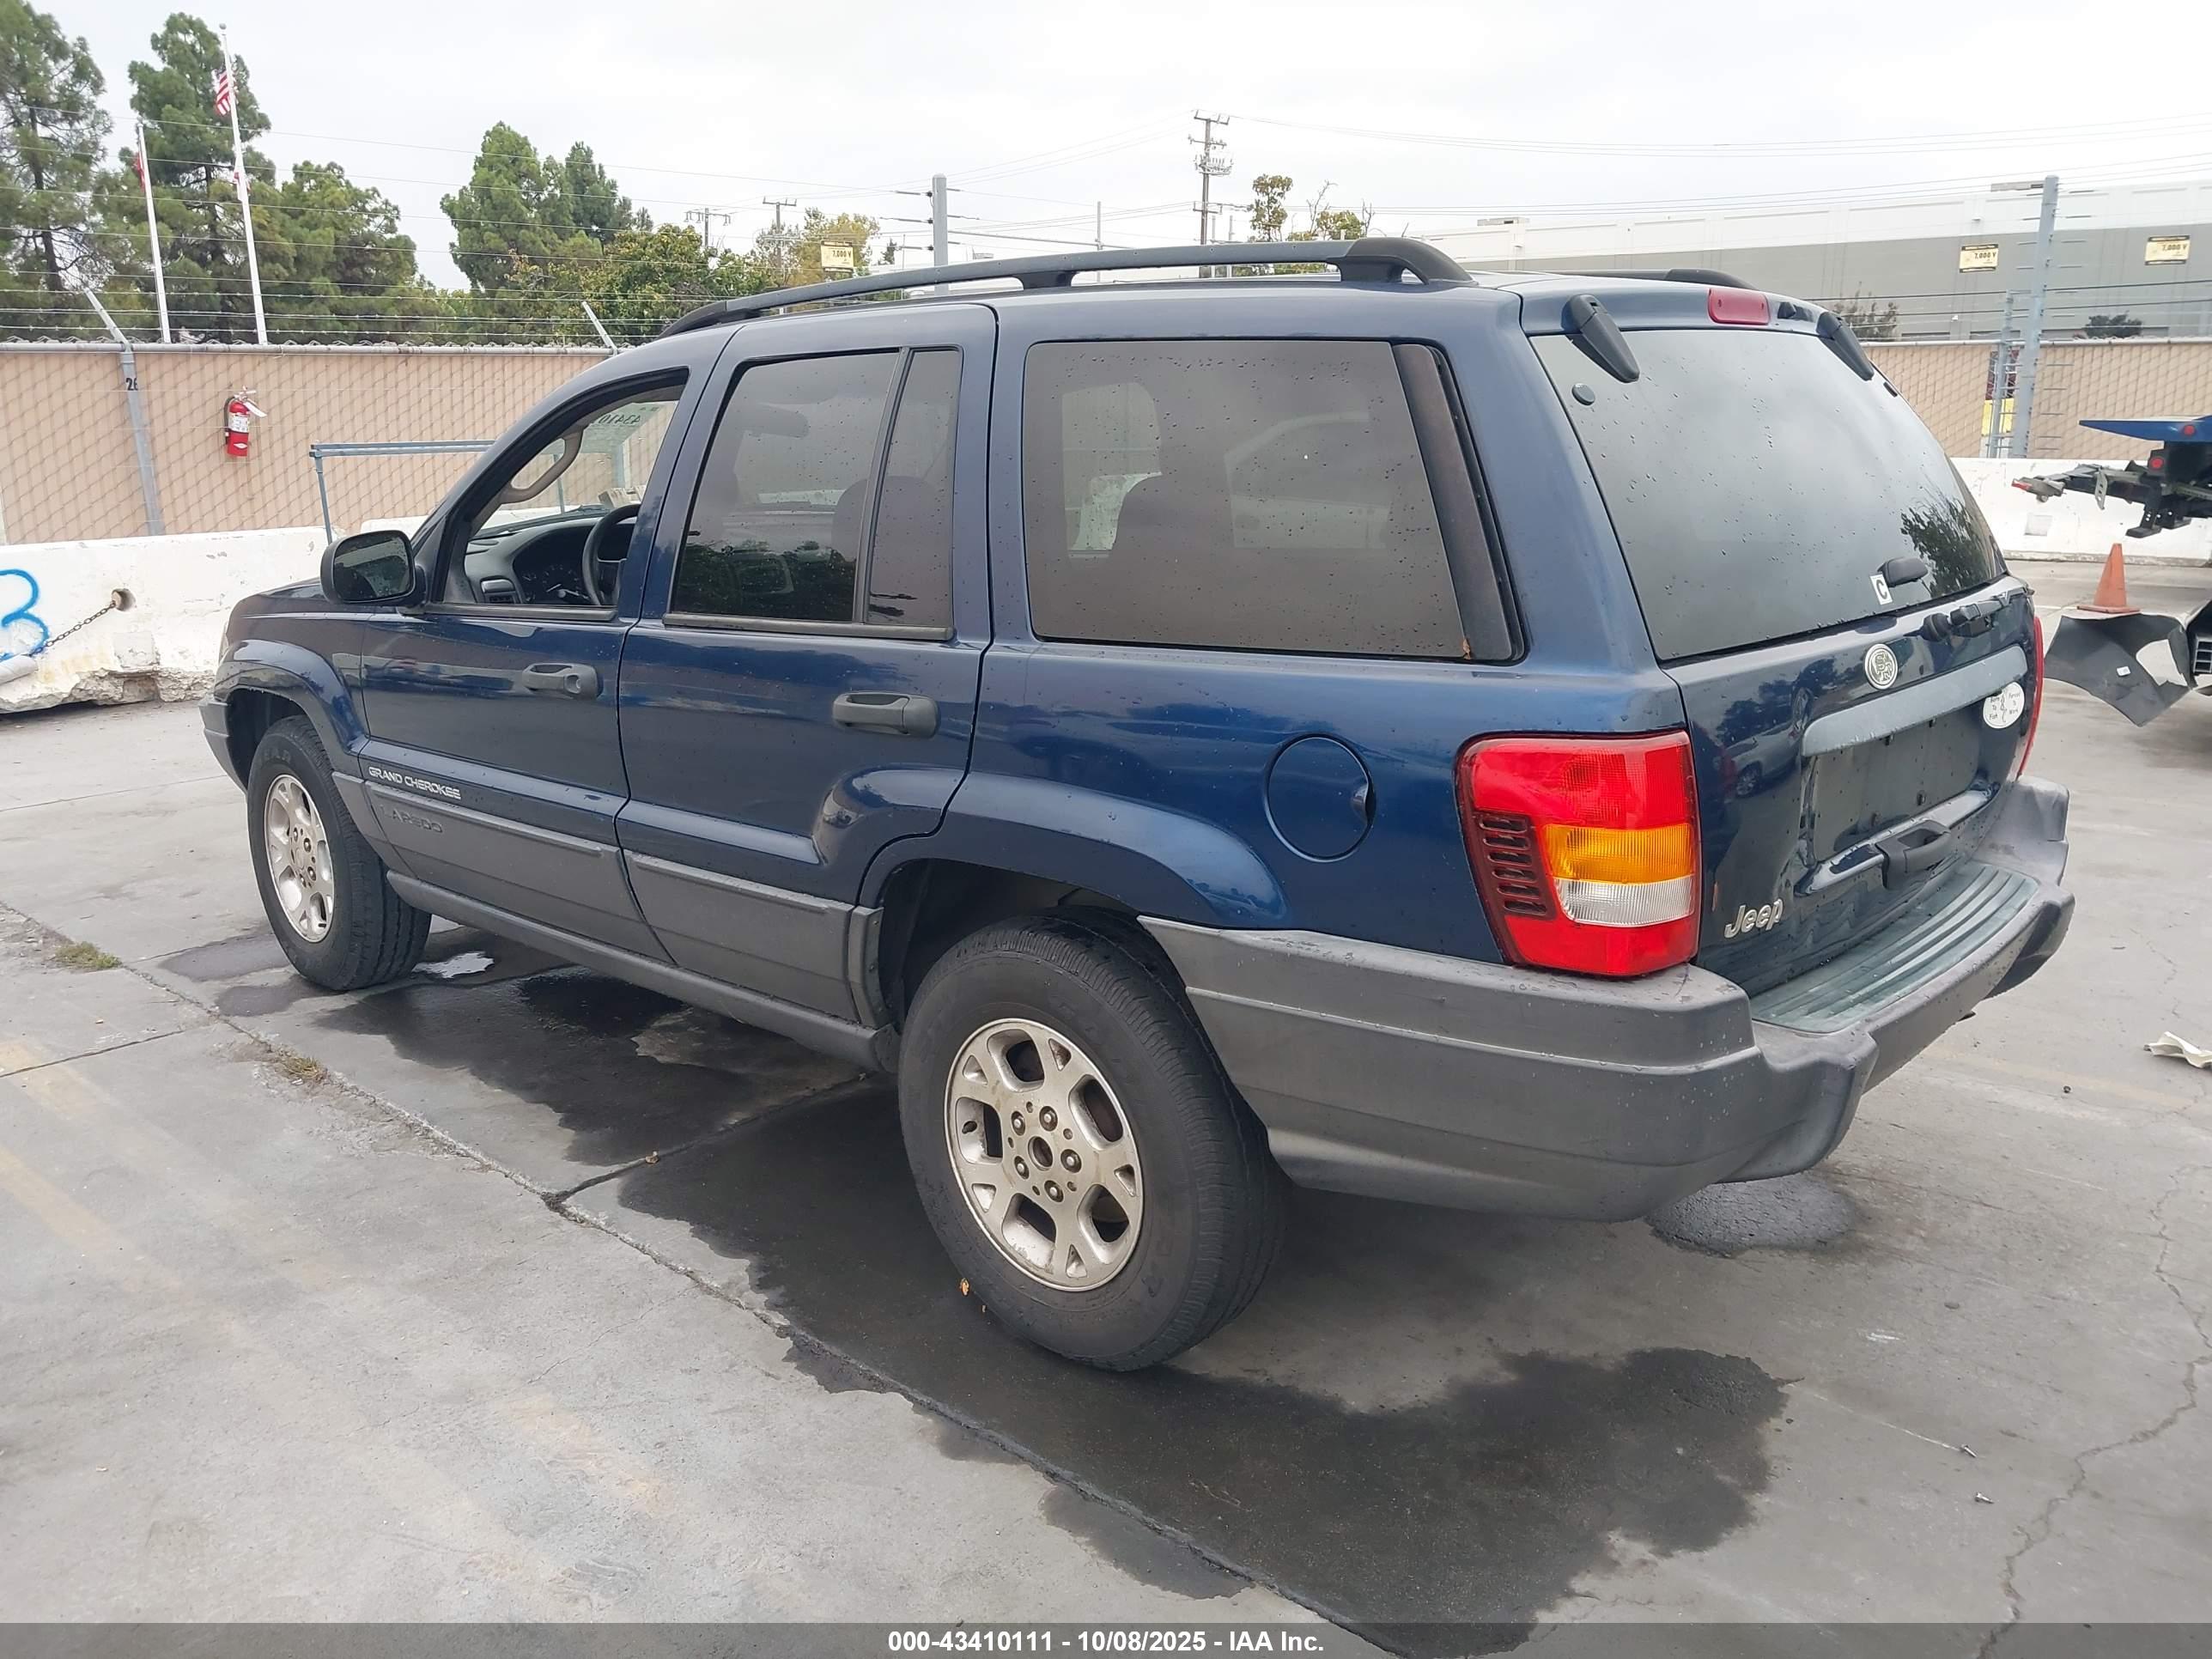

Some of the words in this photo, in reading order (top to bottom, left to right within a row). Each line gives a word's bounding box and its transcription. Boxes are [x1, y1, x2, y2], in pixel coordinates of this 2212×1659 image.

[1875, 579, 1887, 600] C
[369, 766, 403, 784] GRAND
[404, 775, 461, 800] CHEROKEE
[1724, 898, 1784, 939] Jeep
